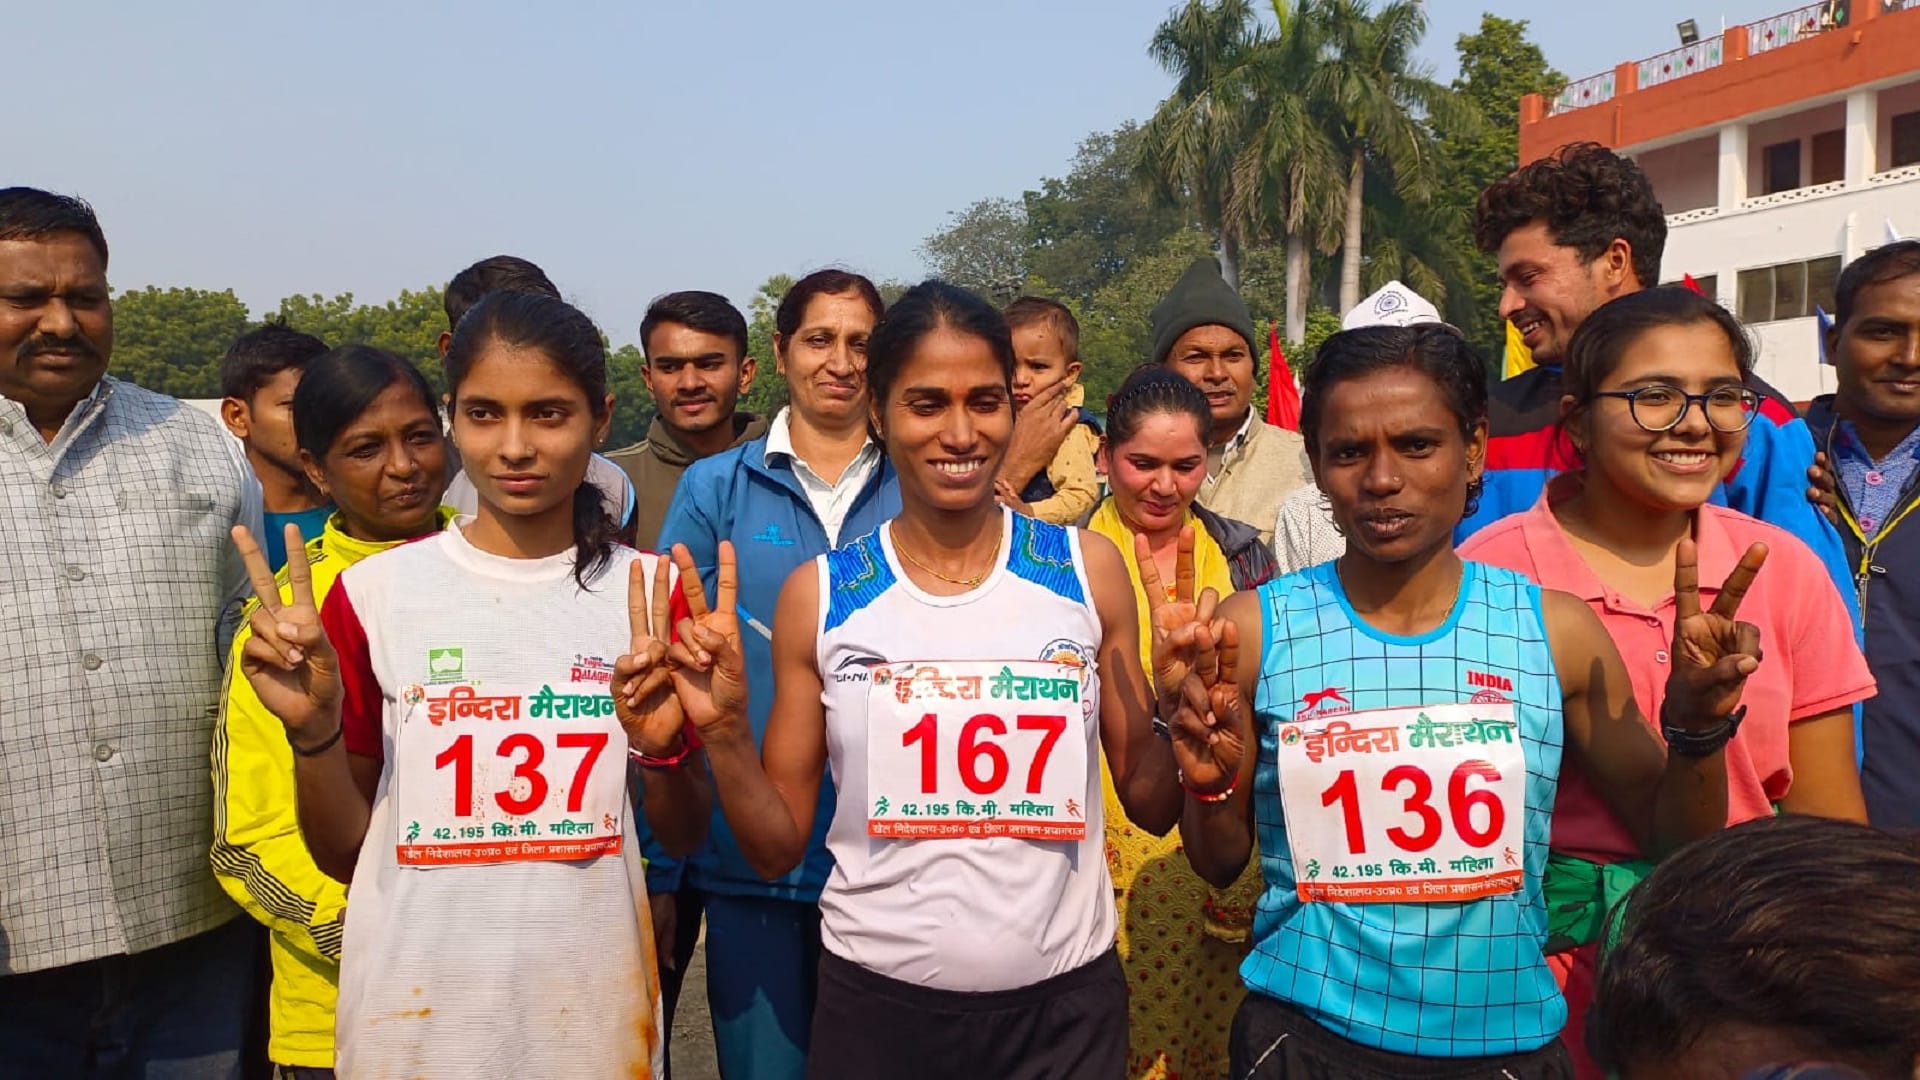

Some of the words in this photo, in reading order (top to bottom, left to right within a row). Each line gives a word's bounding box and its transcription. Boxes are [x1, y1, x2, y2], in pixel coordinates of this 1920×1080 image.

[989, 665, 1079, 703] मैराथन
[1467, 670, 1513, 691] INDIA
[427, 686, 521, 726] इन्दिरा
[903, 713, 1067, 795] 167
[1304, 721, 1399, 763] इन्दिरा
[436, 733, 608, 817] 137
[901, 804, 949, 816] 42.195
[1009, 800, 1054, 816] महिला
[1321, 759, 1505, 854] 136
[433, 827, 484, 839] 42.195
[549, 819, 594, 835] महिला
[1332, 864, 1383, 878] 42.195
[1448, 855, 1494, 872] महिला
